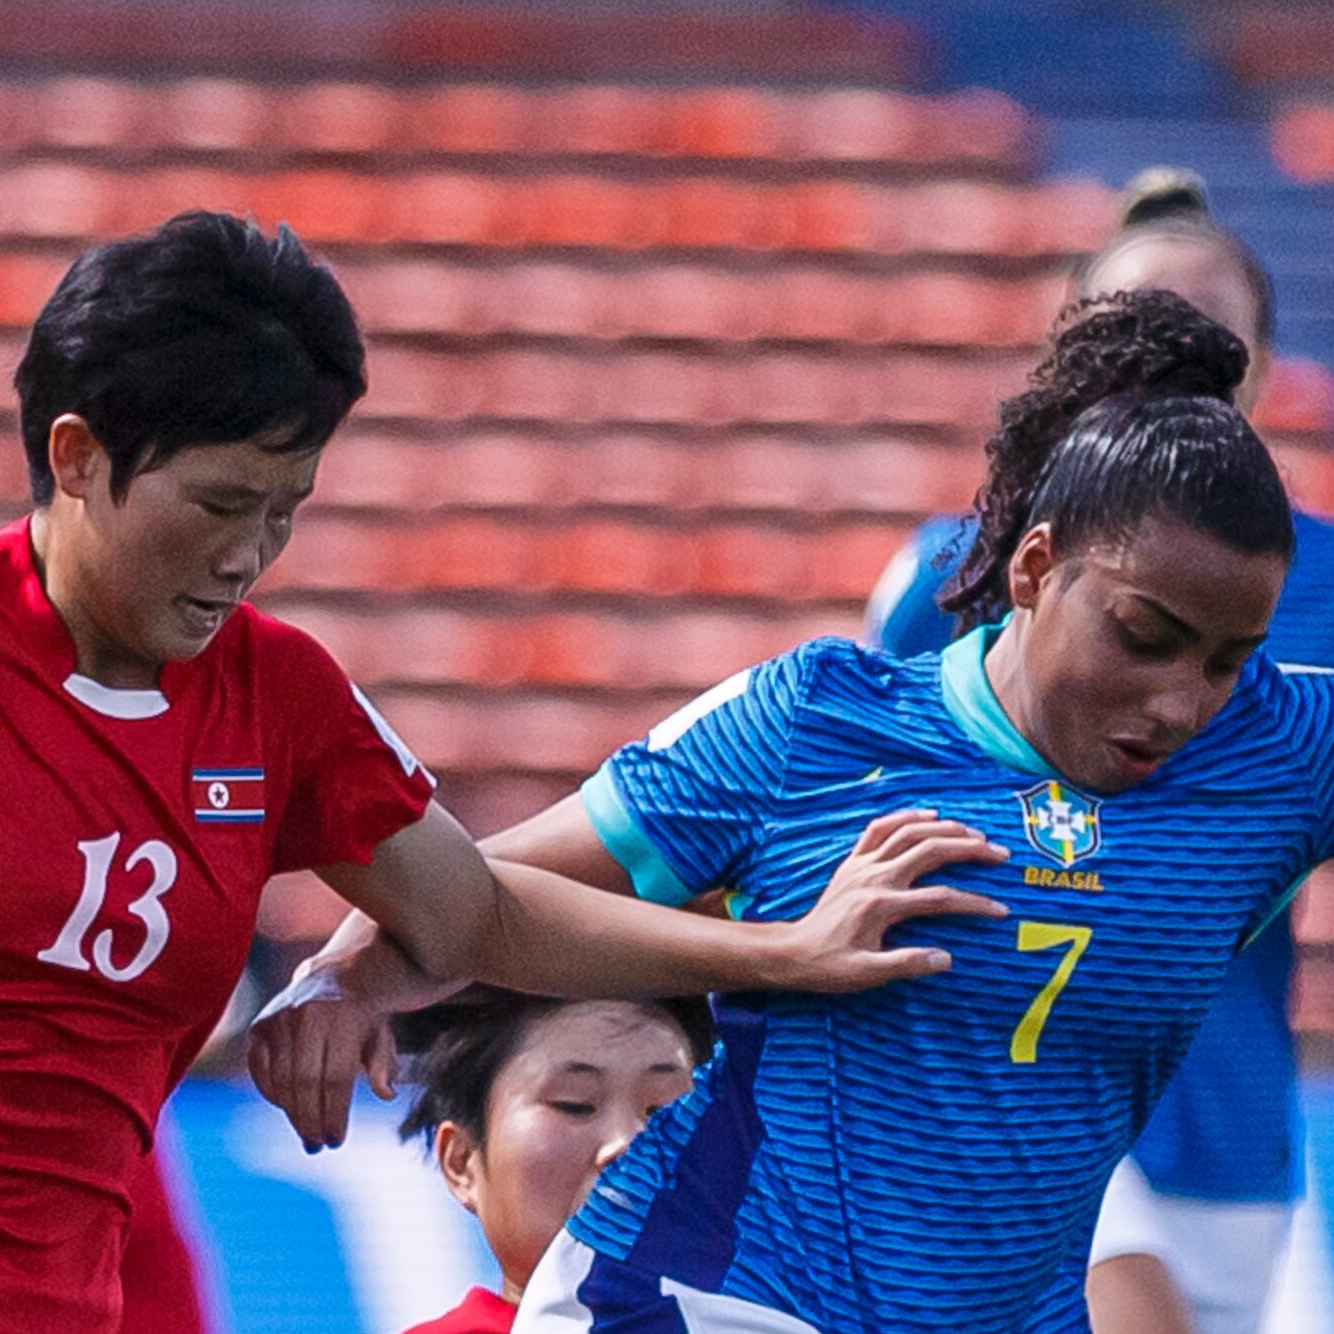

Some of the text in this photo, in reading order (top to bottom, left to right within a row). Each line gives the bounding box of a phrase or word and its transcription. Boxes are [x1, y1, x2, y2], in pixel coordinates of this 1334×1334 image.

[38, 831, 177, 982] 13
[1024, 867, 1104, 892] BRASIL
[1011, 921, 1092, 1063] 7
